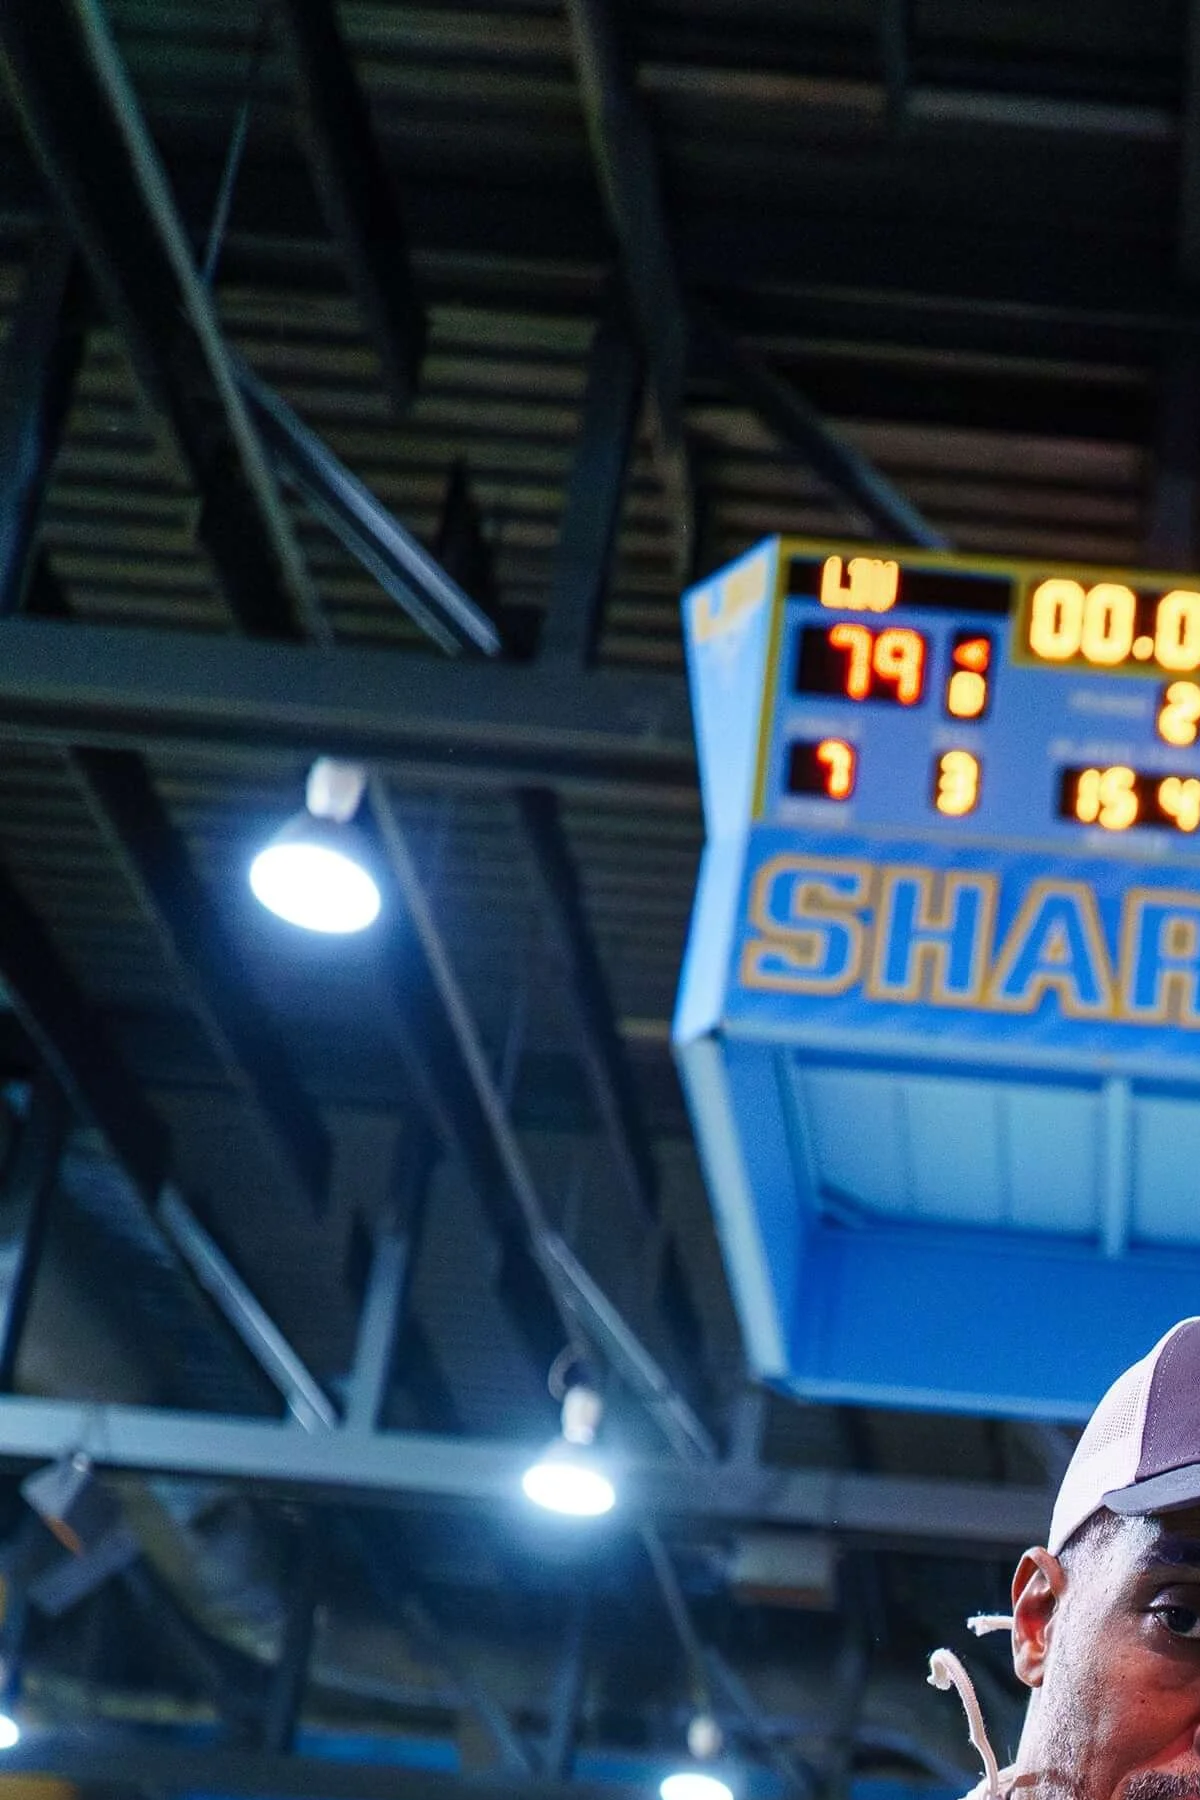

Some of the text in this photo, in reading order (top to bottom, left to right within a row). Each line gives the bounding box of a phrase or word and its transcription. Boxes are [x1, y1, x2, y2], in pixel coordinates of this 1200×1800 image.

[828, 622, 926, 706] 79
[935, 748, 979, 817] 3
[1075, 765, 1139, 831] 15
